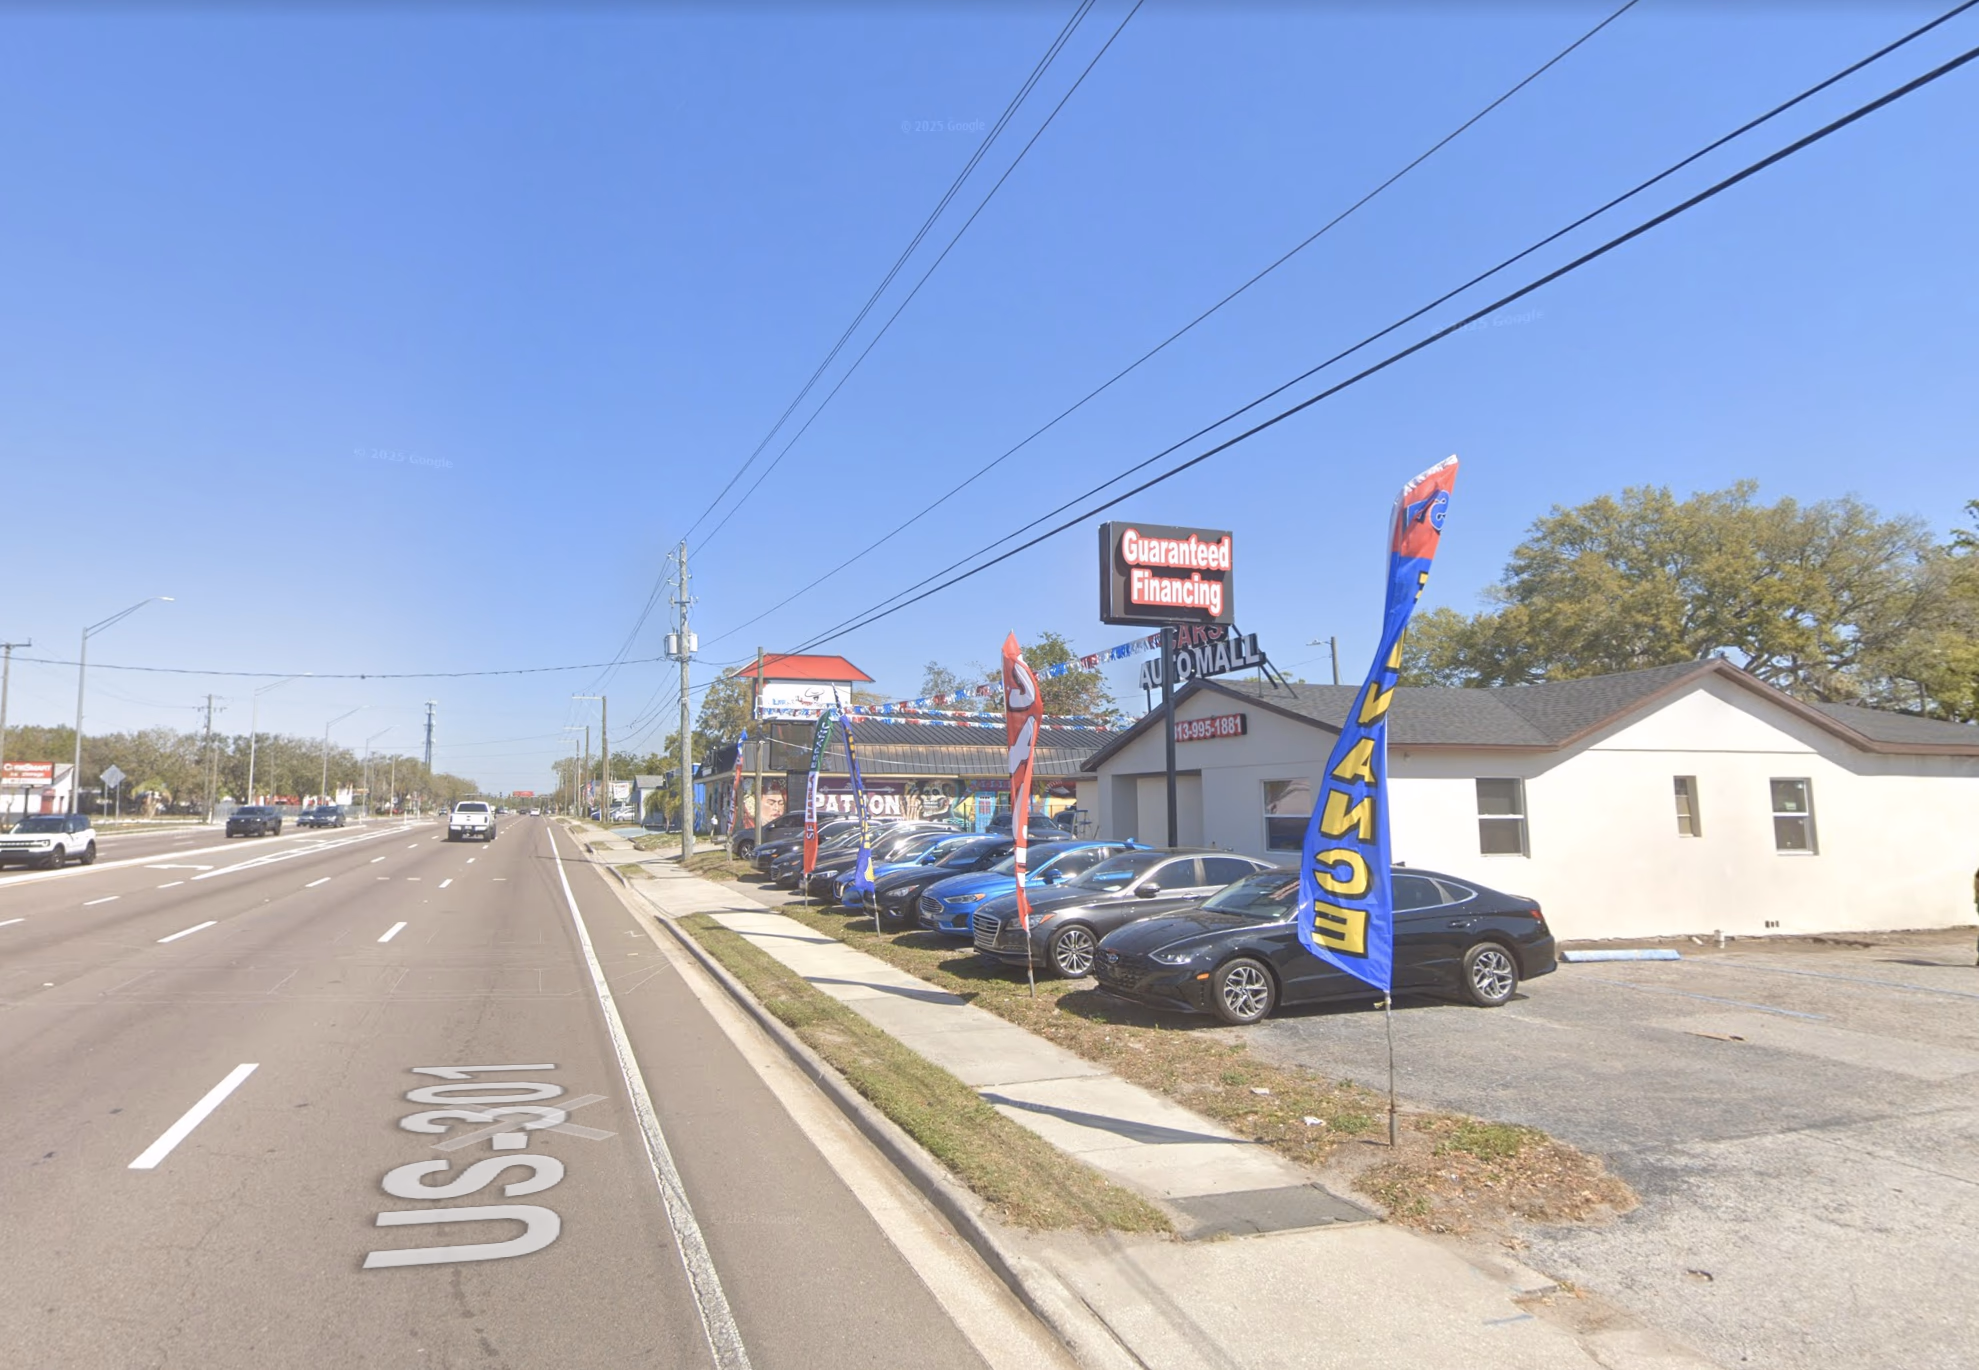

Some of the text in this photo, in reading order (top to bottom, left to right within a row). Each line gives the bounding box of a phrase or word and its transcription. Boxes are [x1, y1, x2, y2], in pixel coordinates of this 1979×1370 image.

[1123, 529, 1231, 570] Guaranteed
[1132, 569, 1223, 615] Financing
[1172, 624, 1224, 649] ARS
[816, 793, 901, 815] PATON
